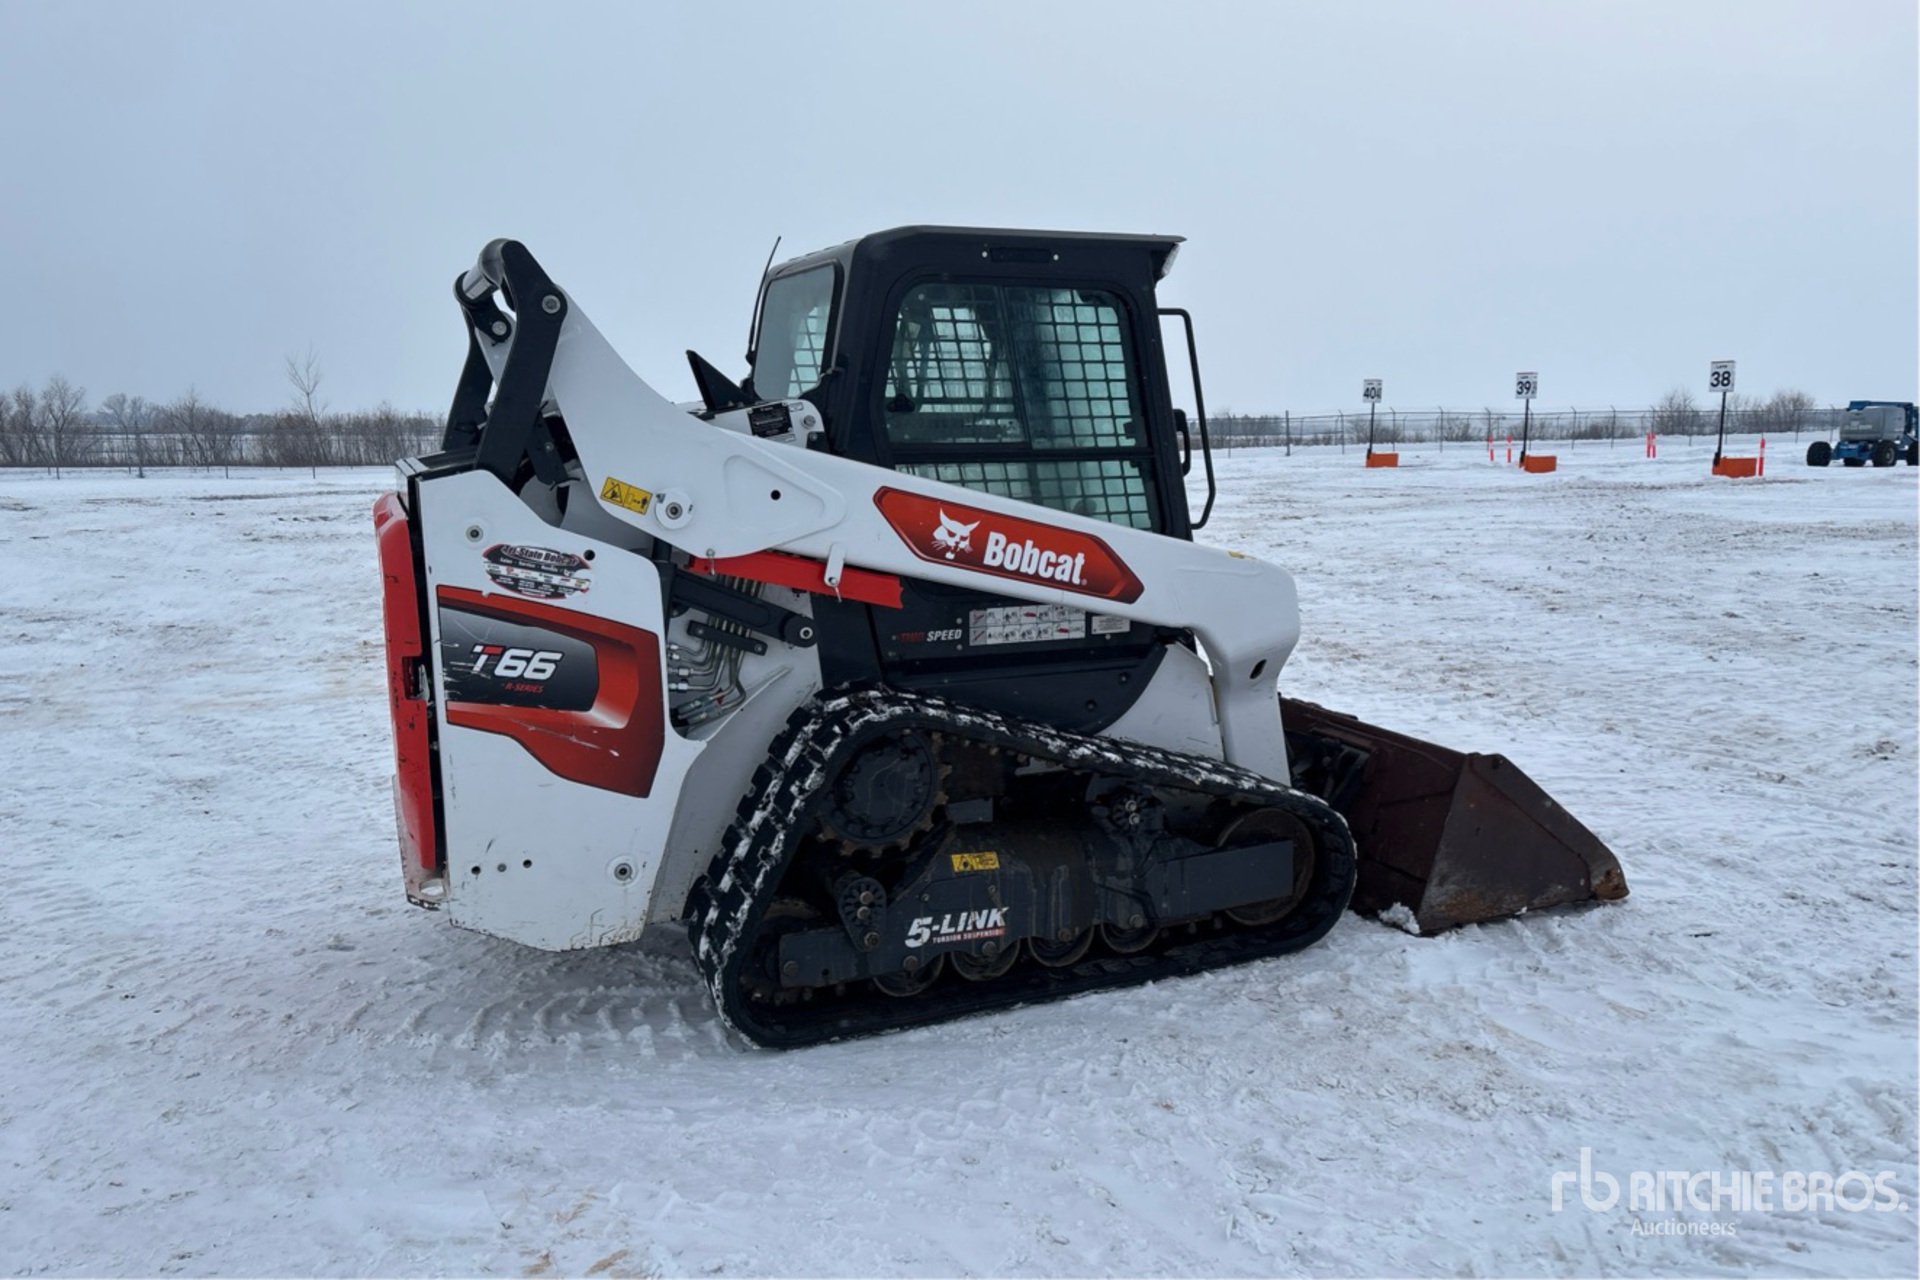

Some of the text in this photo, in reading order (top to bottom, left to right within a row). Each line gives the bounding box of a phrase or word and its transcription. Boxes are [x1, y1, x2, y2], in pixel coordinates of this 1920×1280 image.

[1710, 370, 1731, 387] 38
[1516, 380, 1531, 395] 39
[983, 531, 1086, 585] Bobcat
[927, 629, 962, 642] SPEED
[472, 644, 563, 681] T66
[504, 682, 545, 694] R-SERIES
[905, 906, 1010, 948] 5-LINK
[932, 933, 962, 944] TORSION
